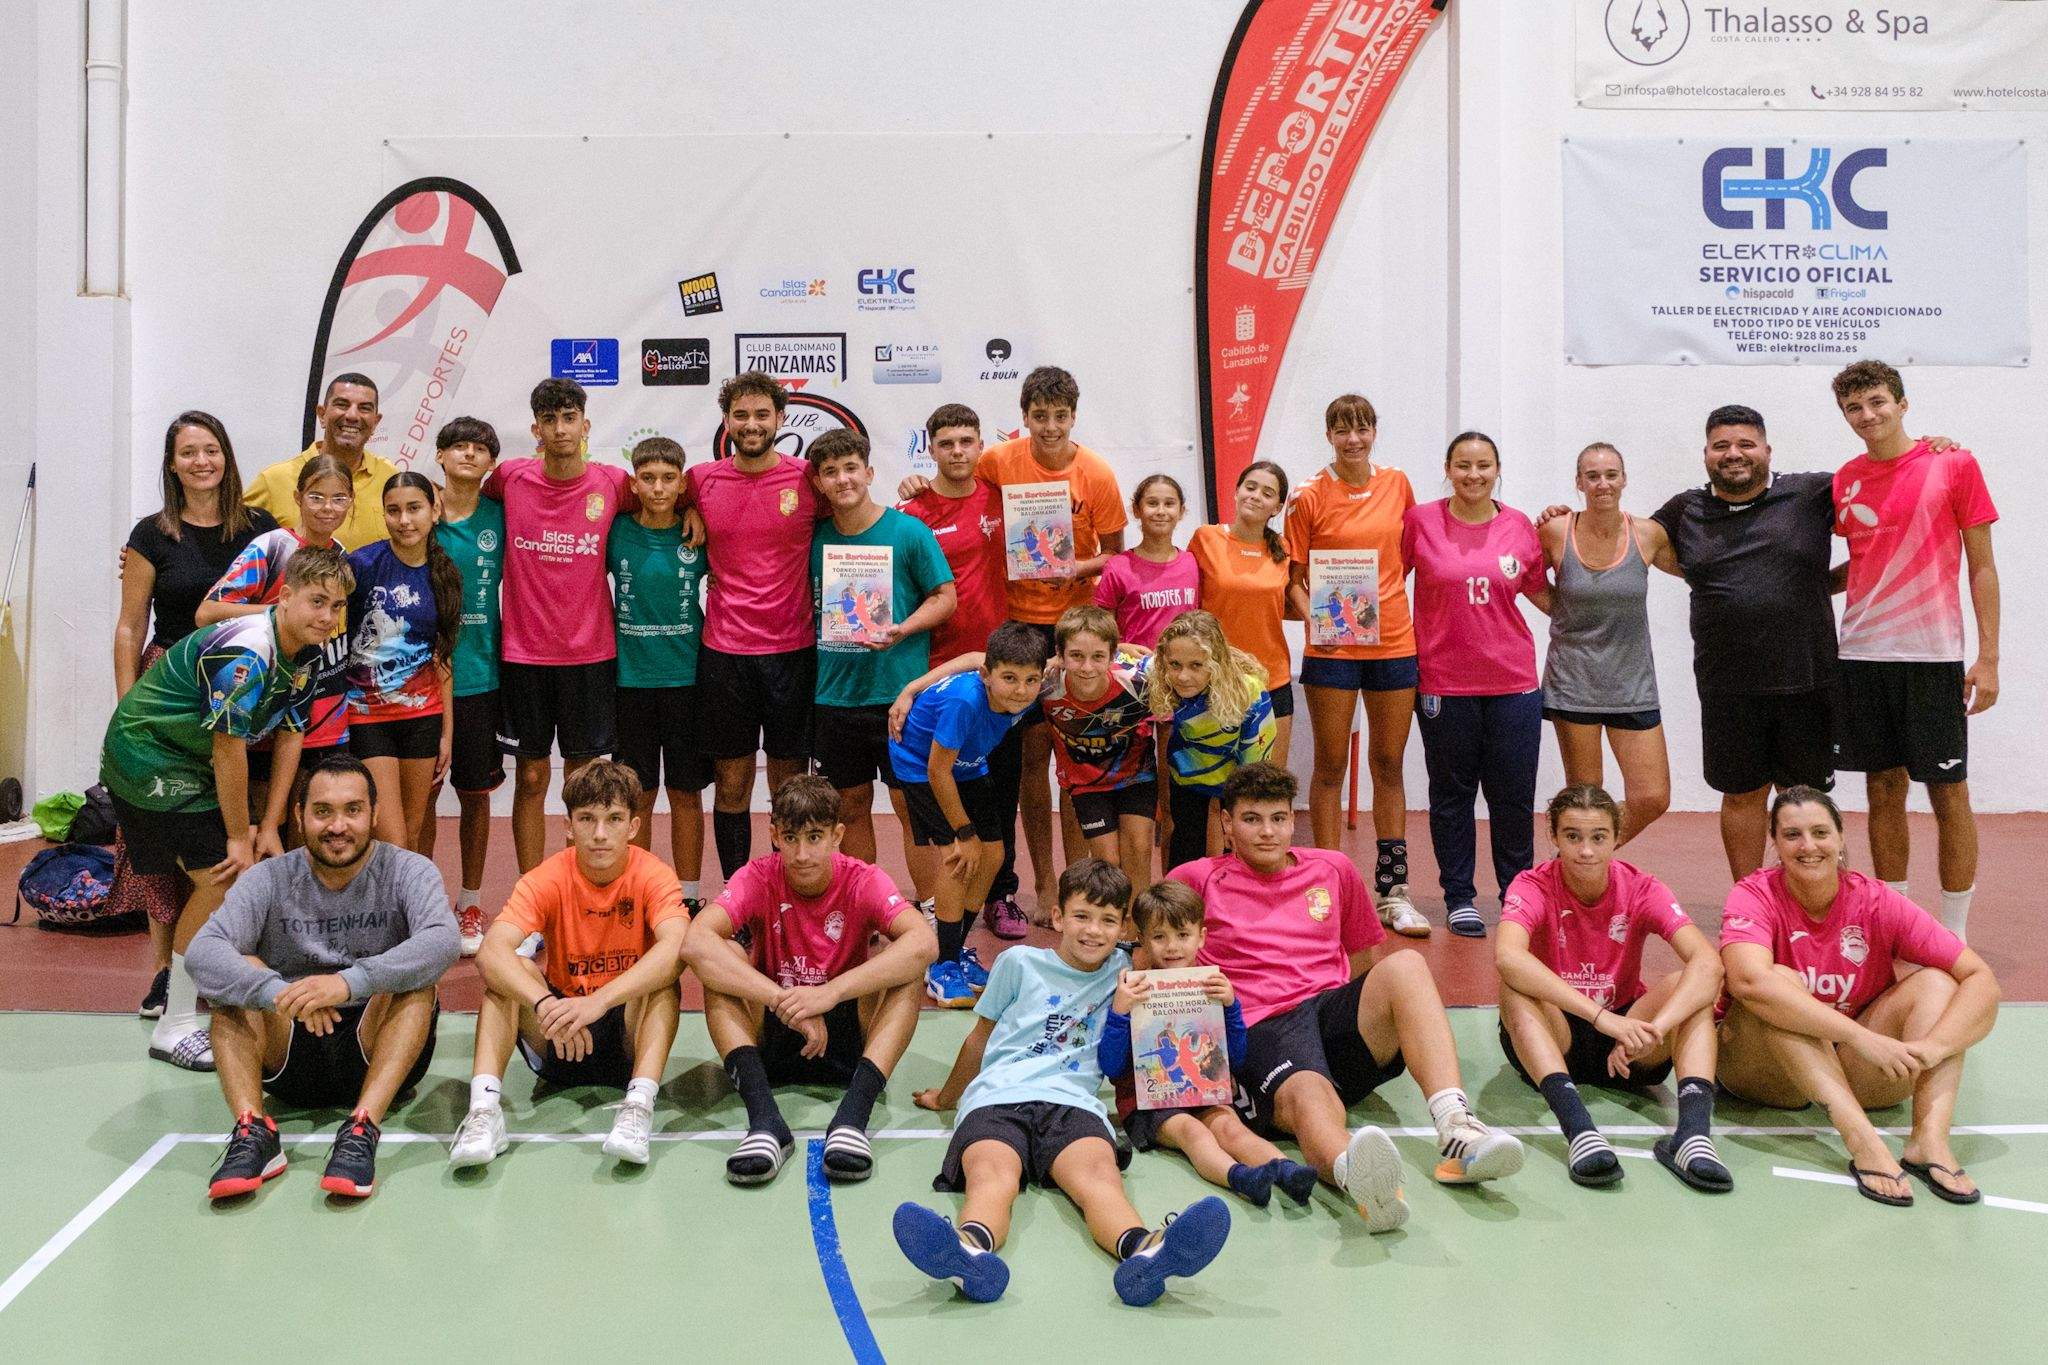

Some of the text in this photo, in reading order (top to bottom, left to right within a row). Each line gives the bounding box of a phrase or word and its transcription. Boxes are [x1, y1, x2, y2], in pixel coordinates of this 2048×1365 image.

[1704, 7, 1929, 41] Thalasso & Spa
[1623, 84, 1787, 102] infospa@hotelcostacalero.es
[1826, 86, 1924, 98] +34 928 84 95 82
[1952, 86, 2048, 98] www.hotelcosta
[1226, 0, 1386, 278] DEPORTE
[1243, 109, 1311, 258] SERVICIO INSULAR DE
[1272, 163, 1324, 276] CABILDO
[1318, 123, 1343, 158] DE
[1699, 266, 1893, 284] SERVICIO OFICIAL
[681, 275, 716, 296] WOOD
[782, 279, 807, 289] Islas
[683, 287, 719, 306] STORE
[760, 287, 807, 298] Canarias
[1743, 288, 1794, 300] hispacold
[1651, 306, 1942, 317] TALLER DE ELECTRICIDAD Y AIRE ACONDICIONADO
[1713, 317, 1881, 329] EN TODO TIPO DE VEHÍCULOS
[1727, 329, 1867, 341] TELÉFONO: 928 80 25 58
[746, 342, 836, 352] CLUB BALONMANO
[1221, 342, 1270, 358] Cabildo de
[1736, 343, 1858, 353] WEB: elektroclima.es
[572, 352, 593, 363] AXA
[747, 355, 836, 374] ZONZAMAS
[1223, 354, 1269, 369] Lanzarote
[980, 371, 989, 380] EL
[407, 325, 469, 441] DEPORTES
[542, 529, 575, 544] Islas
[514, 536, 575, 555] Canarias
[1466, 576, 1490, 605] 13
[1140, 588, 1182, 610] MONSTER
[793, 955, 808, 968] XI
[1580, 962, 1596, 974] XI
[1560, 971, 1607, 981] CAMPUS
[1142, 1001, 1175, 1010] TORNEO
[1185, 999, 1212, 1007] HORAS
[1152, 1006, 1203, 1017] BALONMANO
[1259, 1059, 1293, 1094] hummel
